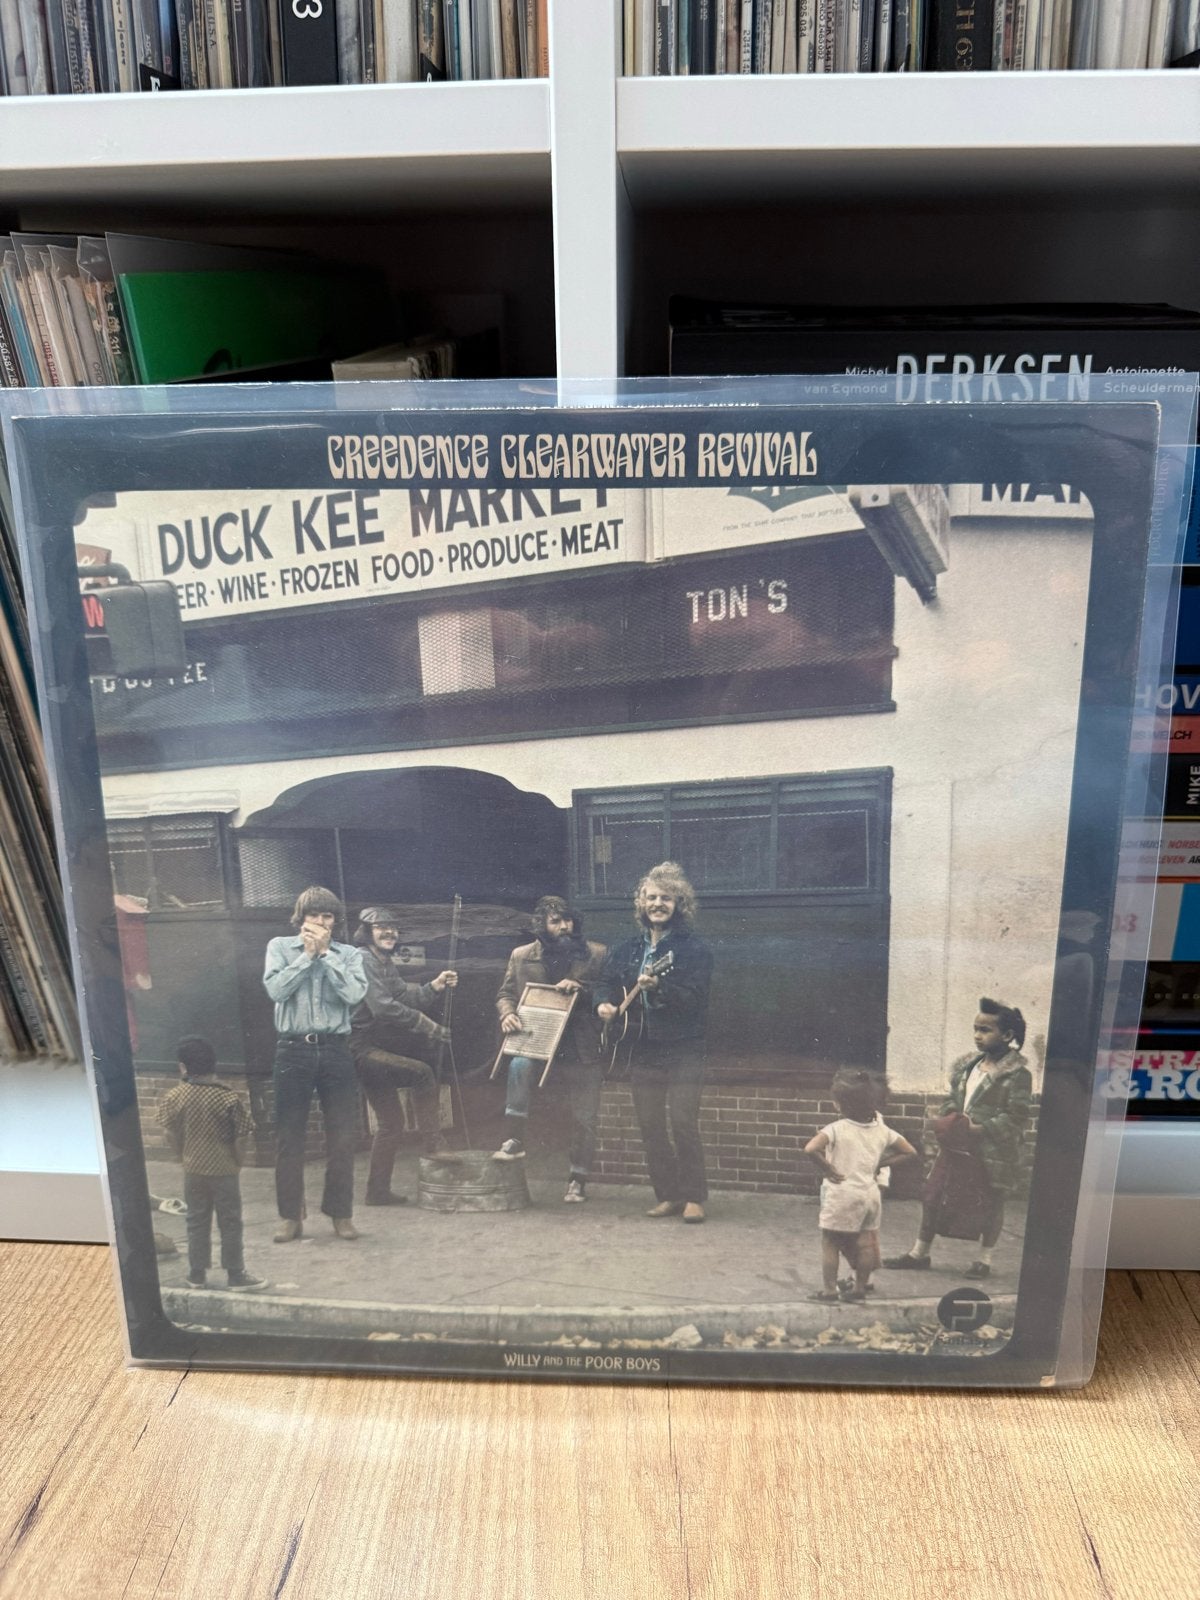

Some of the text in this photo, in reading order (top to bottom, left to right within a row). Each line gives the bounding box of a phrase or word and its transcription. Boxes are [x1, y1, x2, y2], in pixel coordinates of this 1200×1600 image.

[804, 385, 828, 395] van
[832, 383, 888, 397] Egmond
[895, 354, 1093, 402] DERKSEN
[327, 431, 818, 480] CREEDENCE CLEARWATER REVIVAL
[158, 504, 274, 576] DUCK
[292, 489, 385, 555] KEE
[176, 518, 624, 610] EER WINE FROZEN FOOD PRODUCE MEAT
[1185, 765, 1200, 805] MIKE
[503, 1352, 661, 1372] WILLY AND THE POOR BOYS
